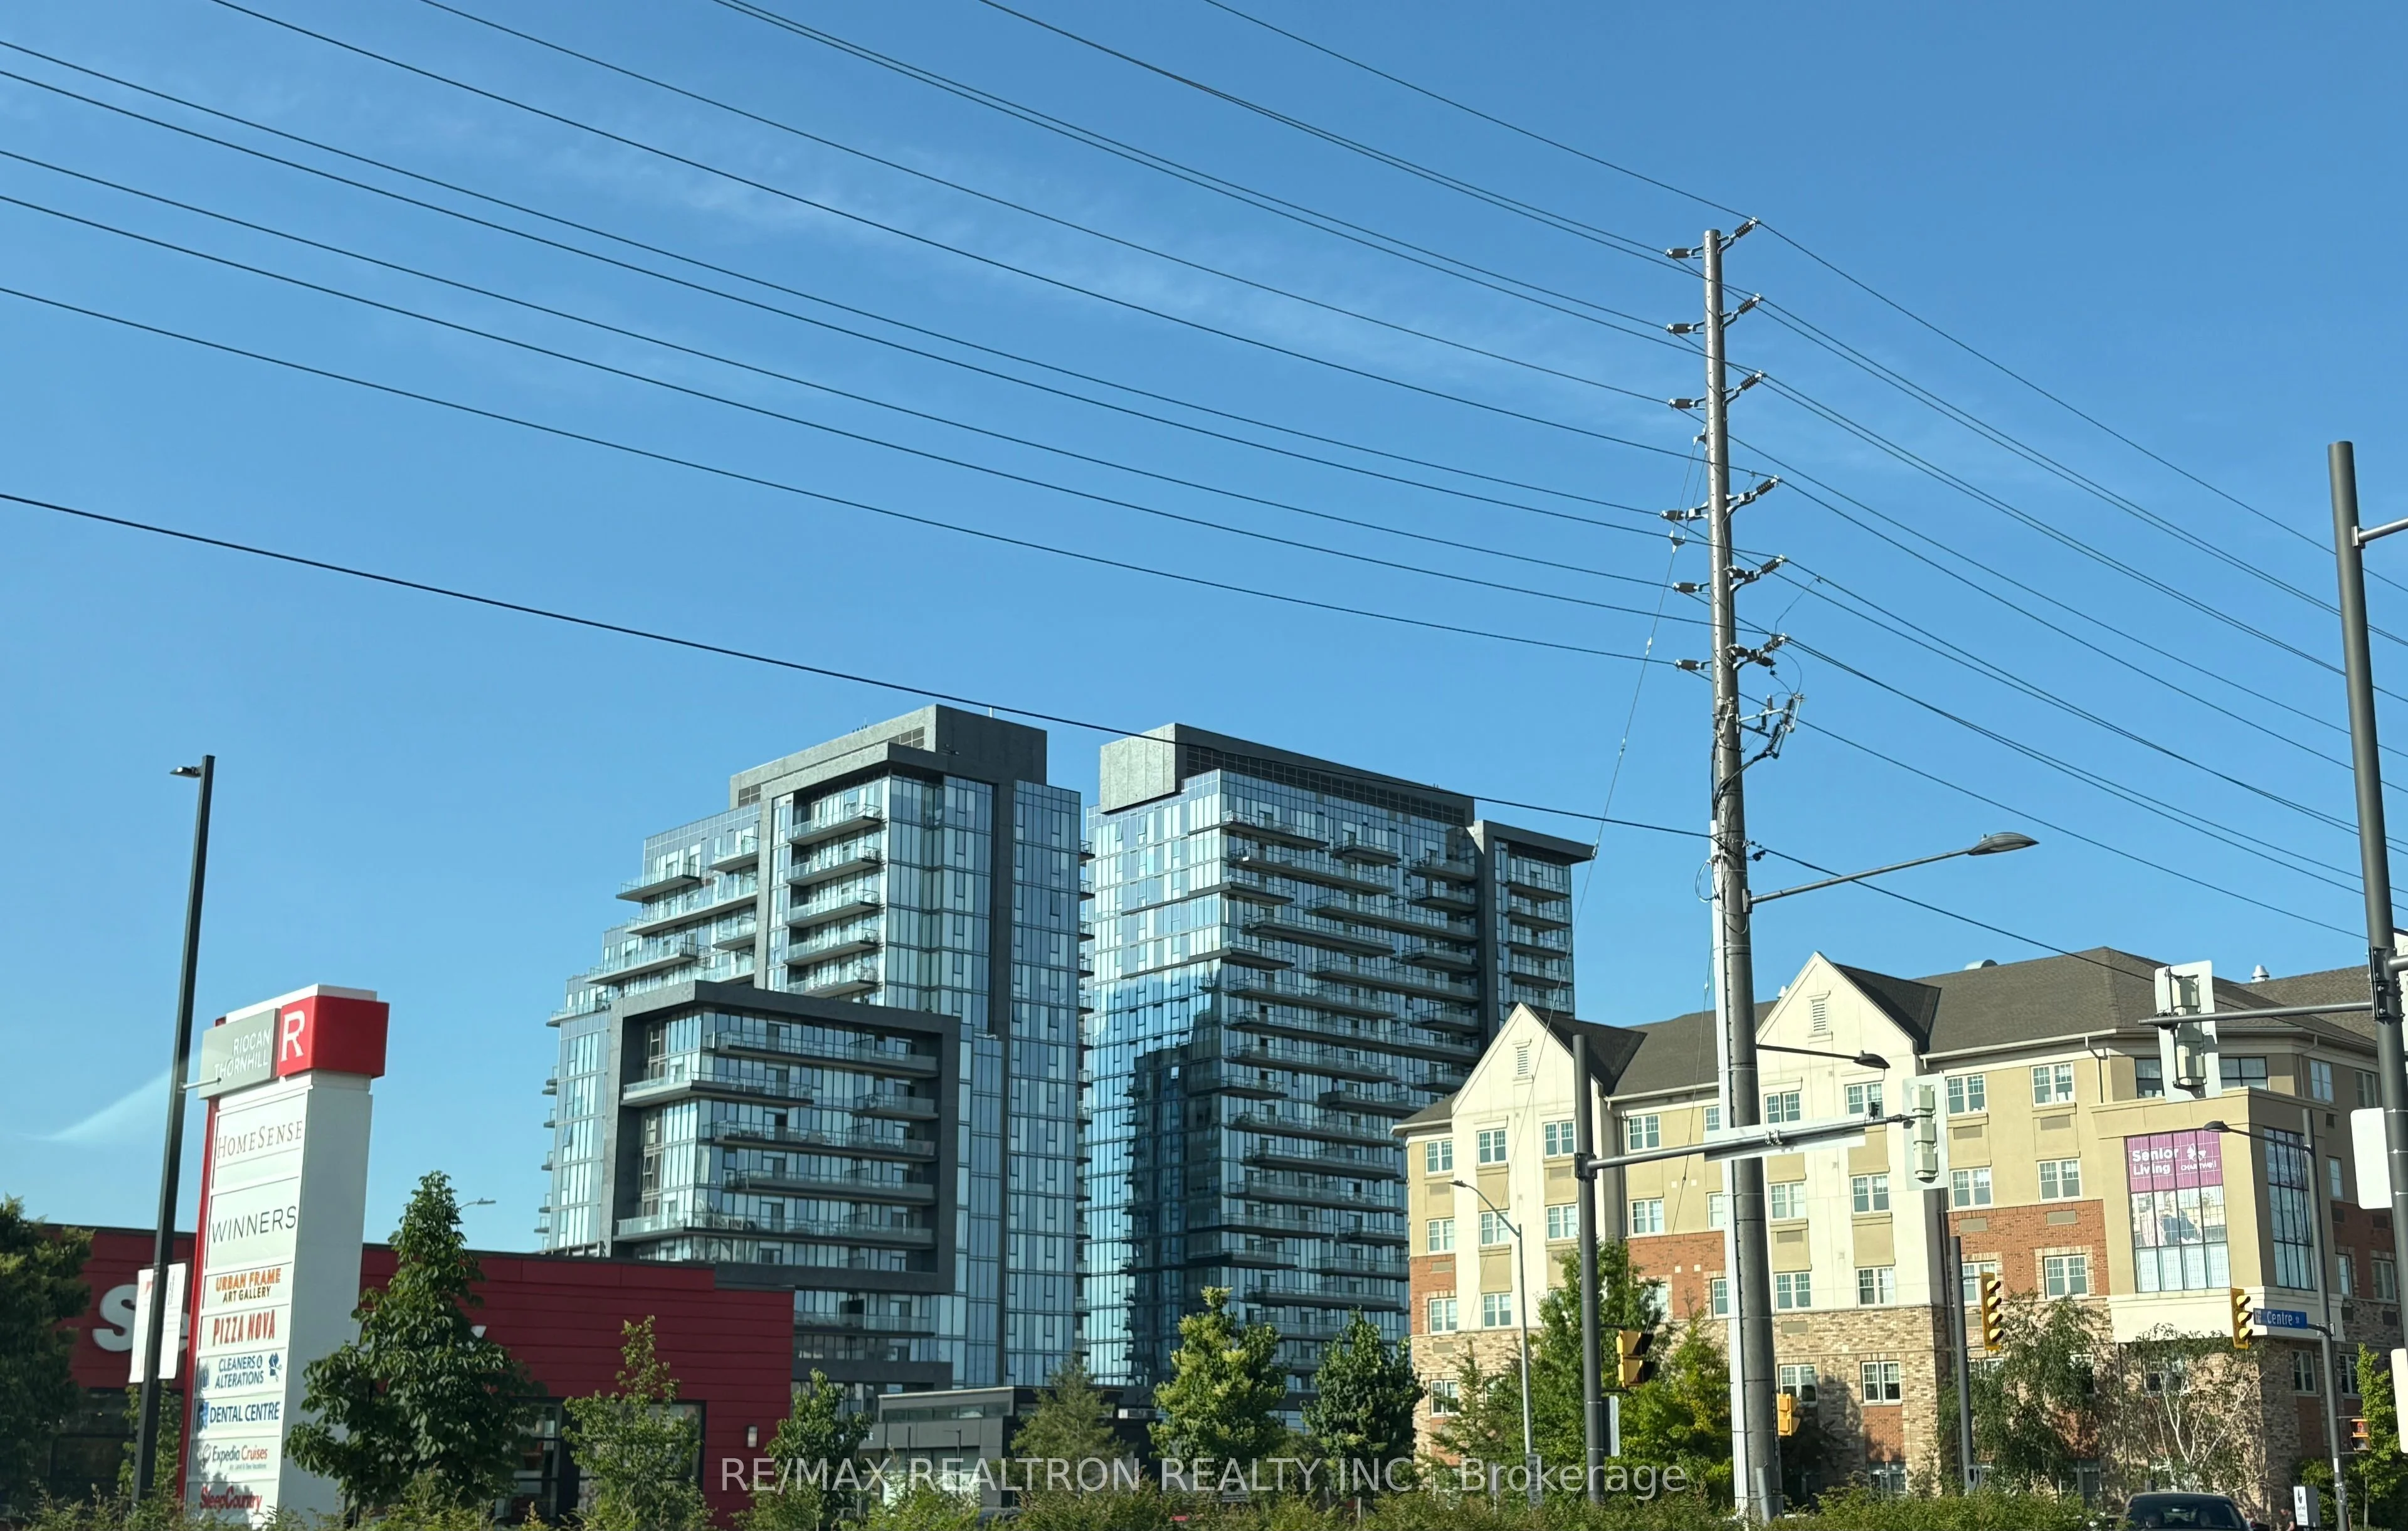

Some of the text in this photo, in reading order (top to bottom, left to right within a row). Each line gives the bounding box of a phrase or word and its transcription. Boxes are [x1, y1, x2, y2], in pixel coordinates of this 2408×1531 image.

[233, 1028, 271, 1056] RIOCAN
[280, 1010, 305, 1062] R
[214, 1049, 268, 1079] THORNHILL
[2132, 1147, 2179, 1162] Senior
[2133, 1163, 2170, 1175] Living
[212, 1205, 297, 1244] WINNERS
[215, 1268, 281, 1292] URBAN FRAME
[223, 1286, 271, 1304] ART GALLERY
[213, 1315, 244, 1347] PIZZA
[247, 1309, 275, 1342] NOVA
[2267, 1311, 2293, 1325] Centre
[218, 1355, 256, 1373] CLEANERS
[214, 1370, 265, 1389] ALTERATIONS
[209, 1401, 280, 1424] DENTAL CENTRE
[212, 1444, 268, 1468] Expedia Cruises
